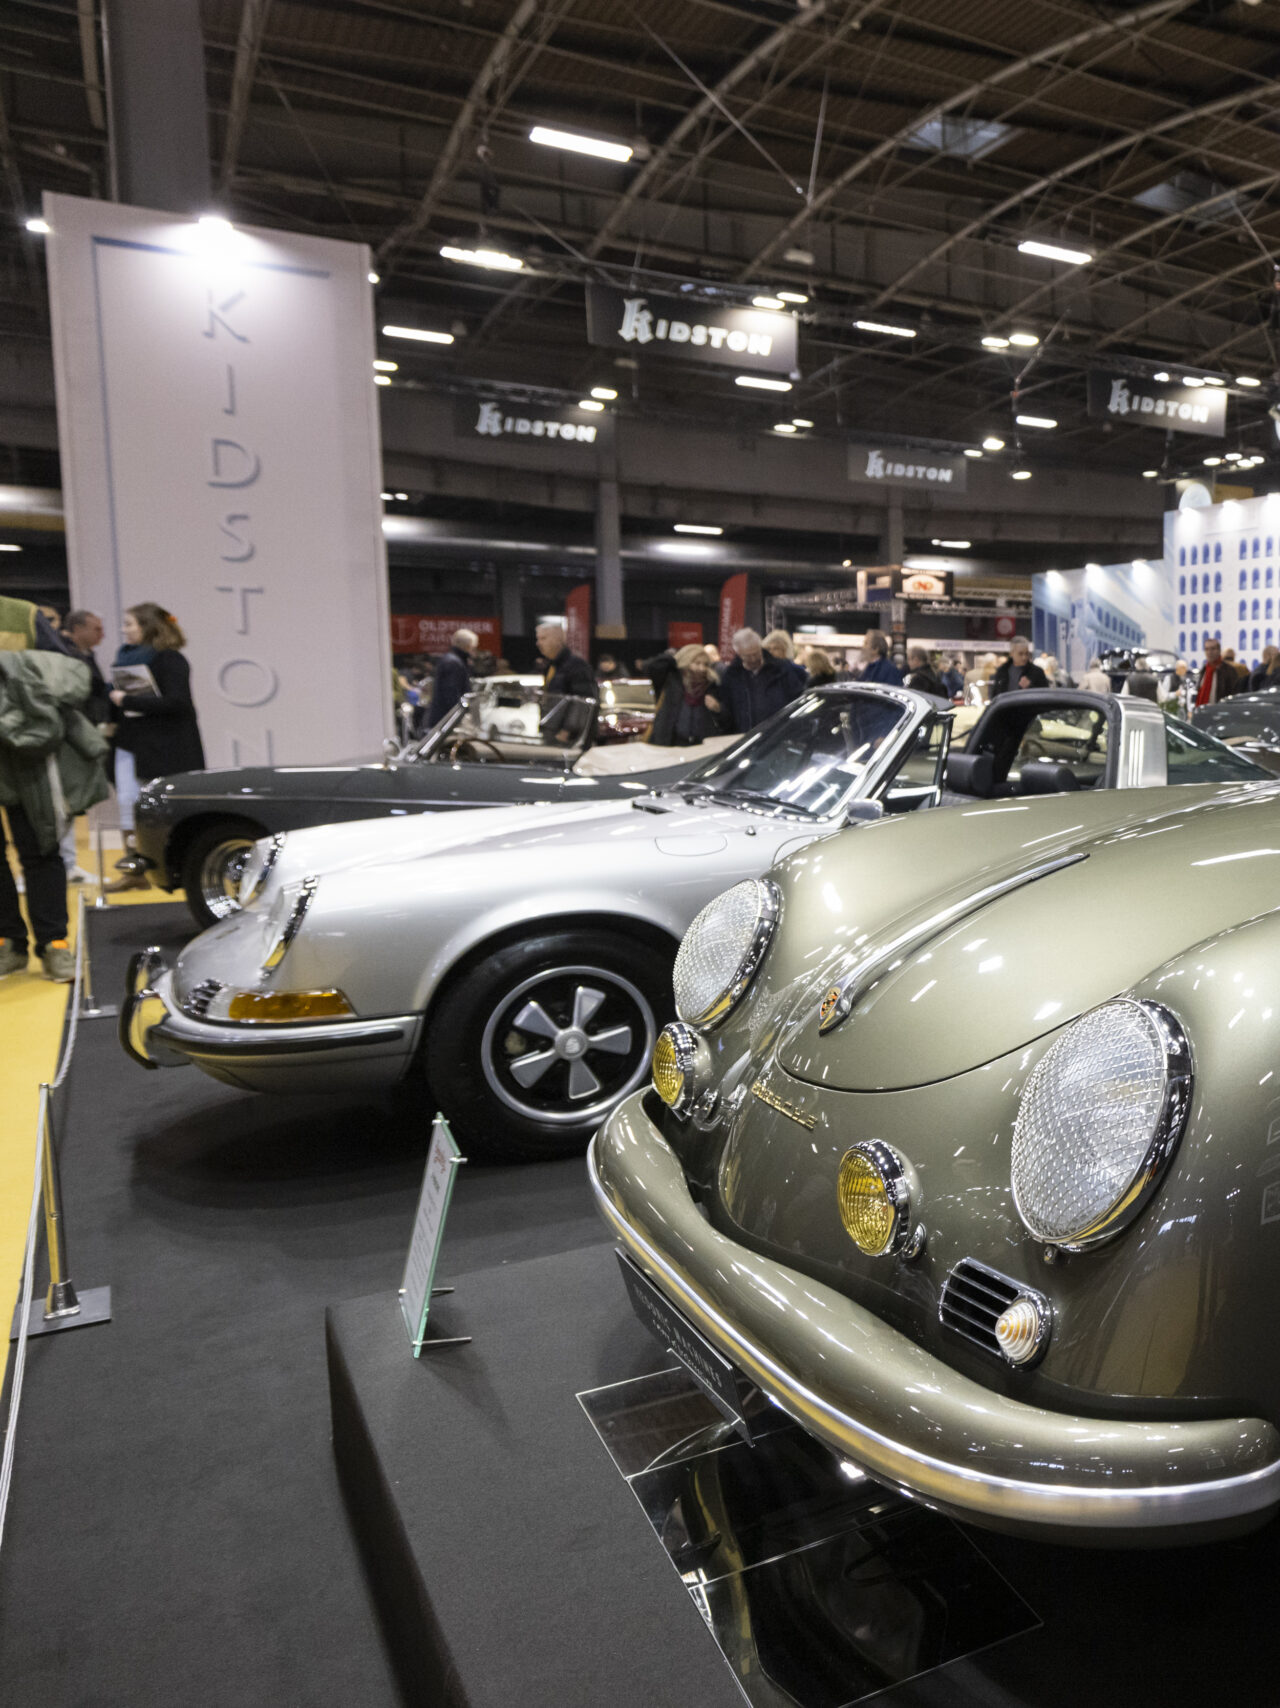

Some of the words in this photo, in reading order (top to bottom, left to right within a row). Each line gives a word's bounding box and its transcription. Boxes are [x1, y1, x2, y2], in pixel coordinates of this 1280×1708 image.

[617, 298, 773, 357] KIDSTON
[475, 402, 597, 443] KIDSTON
[1107, 379, 1209, 423] KIDSTON
